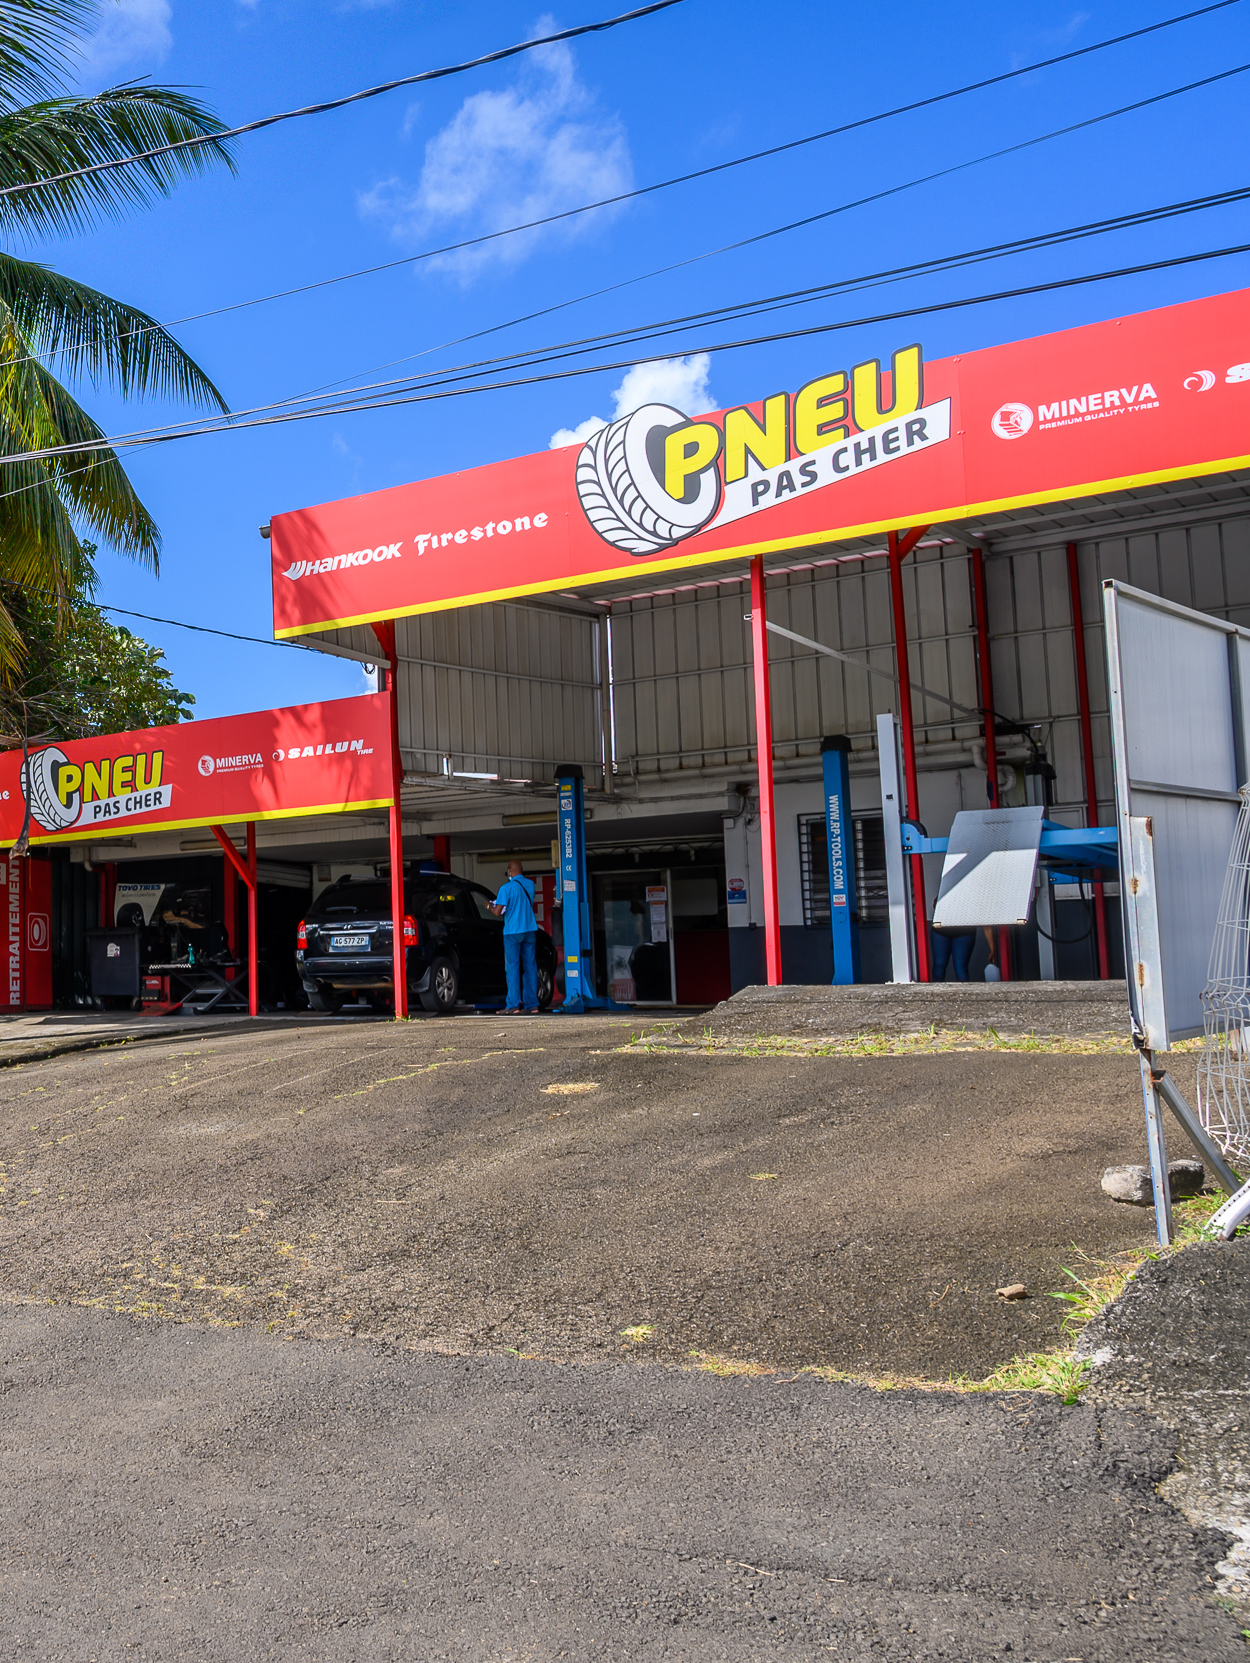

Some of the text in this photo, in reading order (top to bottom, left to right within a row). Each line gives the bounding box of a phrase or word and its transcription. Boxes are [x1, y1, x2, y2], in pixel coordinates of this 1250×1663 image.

[663, 345, 922, 500] PNEU
[1037, 382, 1158, 422] MINERVA
[1039, 401, 1160, 431] PREMIUM QUALITY TYRES
[751, 417, 929, 507] PAS CHER
[414, 511, 549, 557] Firestone
[216, 752, 263, 768] MINERVA
[287, 738, 364, 759] SAILUN
[356, 747, 374, 756] TIRE
[58, 751, 164, 806] PNEU
[93, 790, 163, 819] PAS CHER
[828, 794, 844, 890] WWW.RP-TOOLS.COM
[9, 859, 20, 1005] RETRAITEMENT
